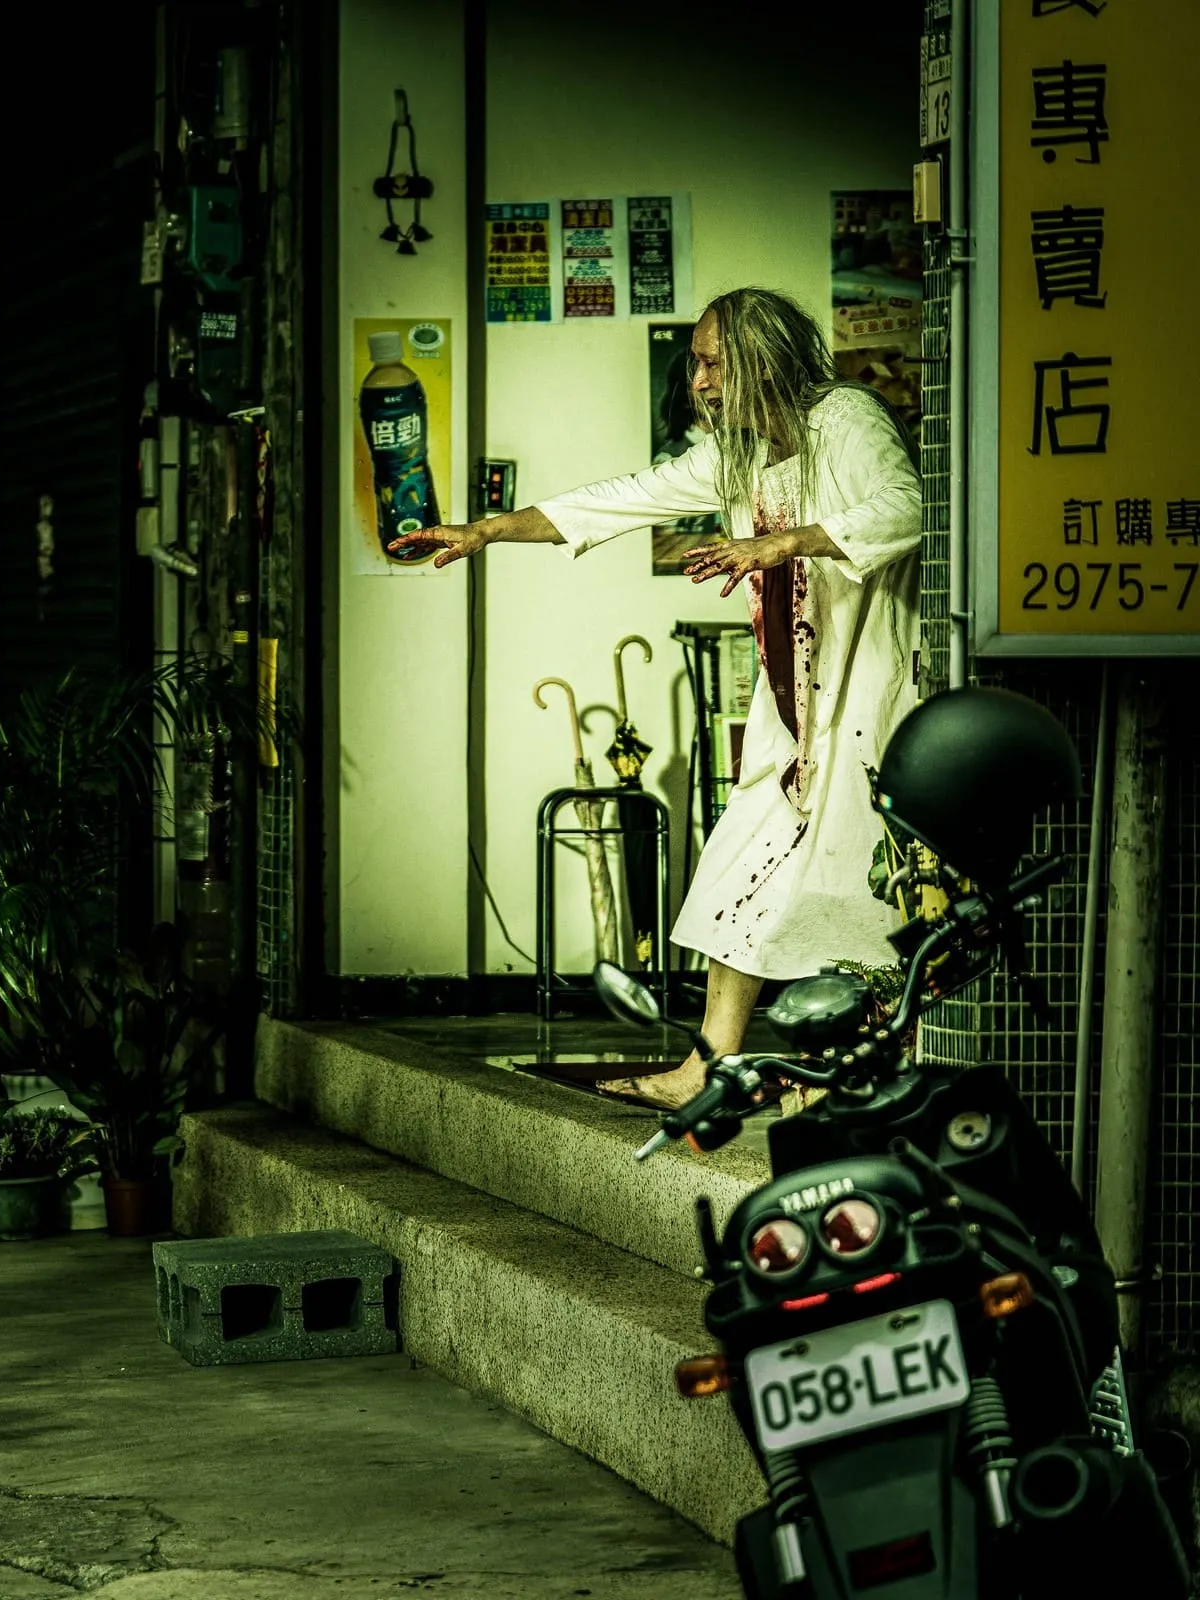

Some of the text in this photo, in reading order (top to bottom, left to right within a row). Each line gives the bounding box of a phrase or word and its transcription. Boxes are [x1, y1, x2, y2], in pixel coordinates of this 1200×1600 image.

[934, 91, 950, 137] 13
[1027, 0, 1113, 456] 專賣店
[1063, 498, 1200, 547] 訂購專
[1022, 562, 1199, 611] 2975-7
[778, 1177, 854, 1216] YAMAHA
